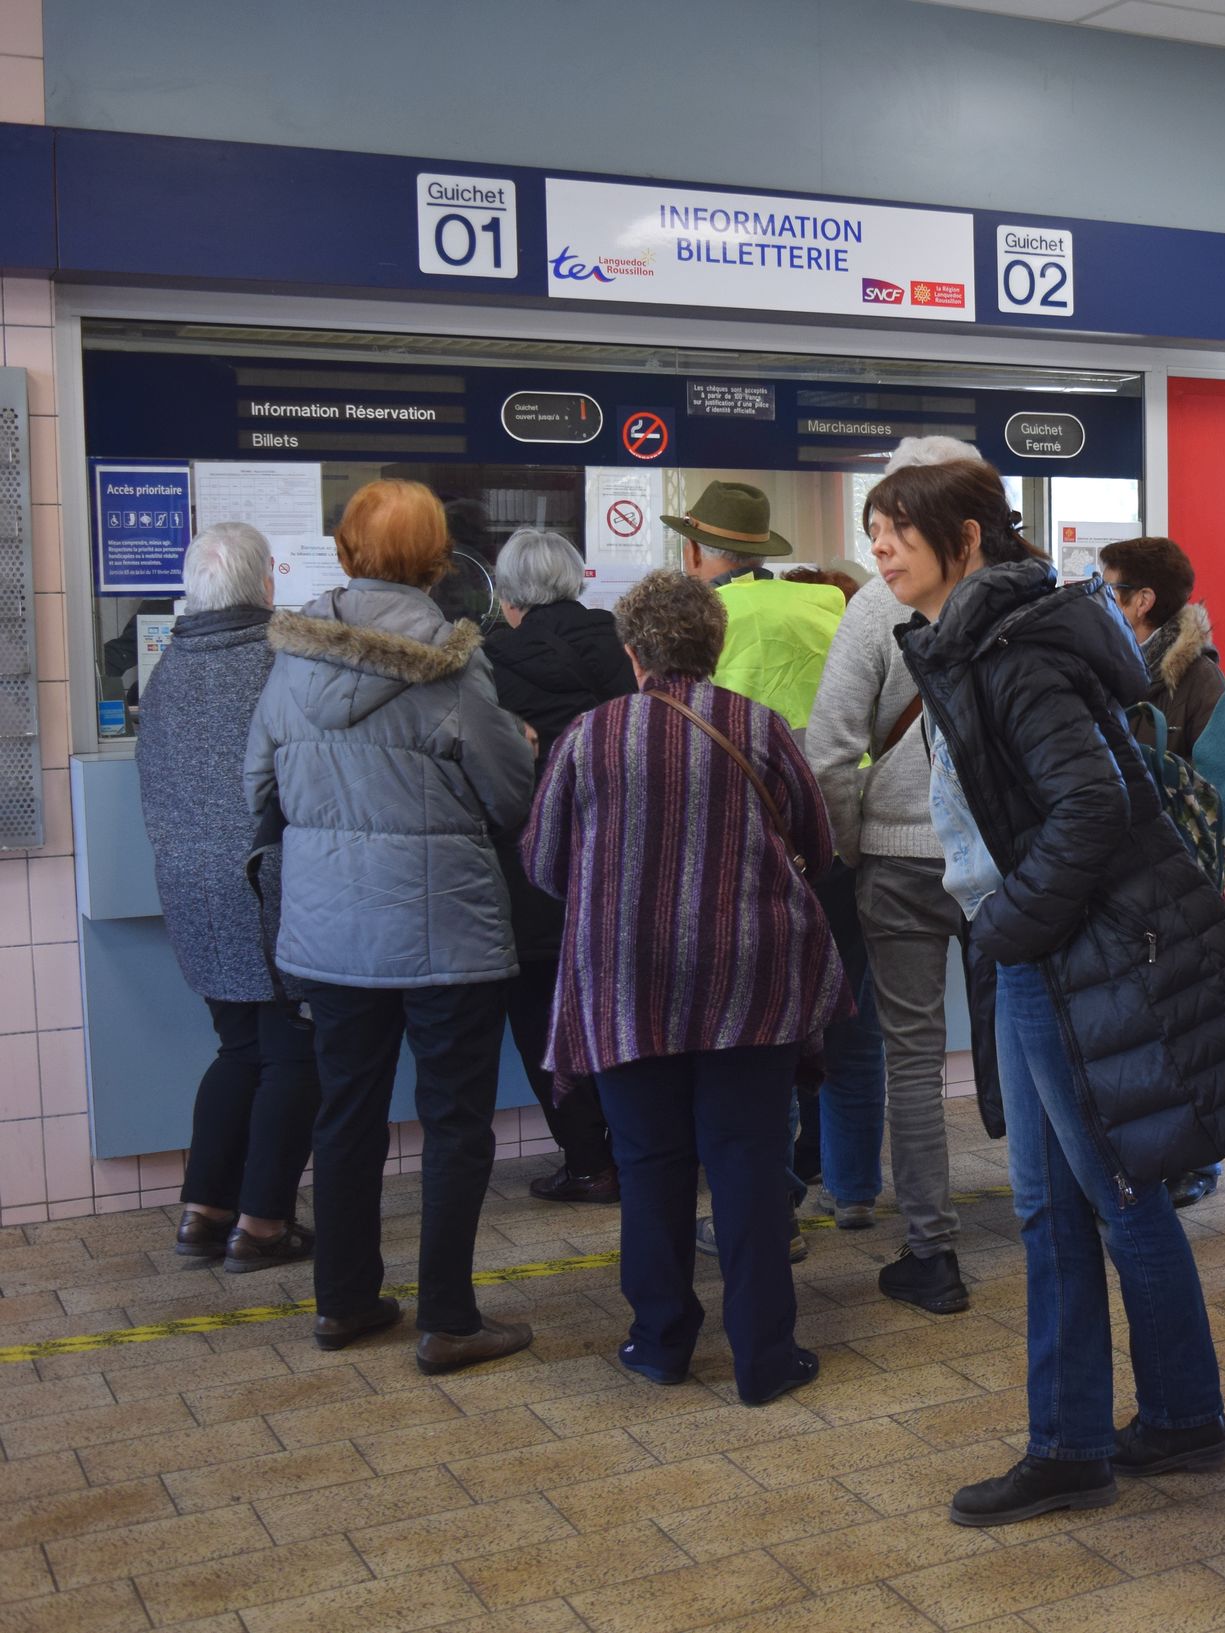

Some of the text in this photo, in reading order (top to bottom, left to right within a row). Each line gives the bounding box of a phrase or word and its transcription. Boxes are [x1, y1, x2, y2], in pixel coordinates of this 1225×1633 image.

[428, 182, 505, 205] Guichet
[660, 204, 862, 243] INFORMATION
[434, 213, 502, 269] 01
[1005, 232, 1064, 252] Guichet
[598, 256, 647, 267] Languedoc
[677, 237, 849, 272] BILLETTERIE
[549, 246, 616, 283] ter
[607, 265, 654, 276] Roussillon
[1003, 259, 1068, 309] 02
[864, 287, 903, 302] SNCF
[251, 402, 436, 420] Information Réservation
[514, 404, 539, 412] Guichet
[538, 413, 560, 422] jusqu'à
[808, 420, 892, 435] Marchandises
[1021, 423, 1063, 436] Guichet
[252, 433, 299, 448] Billets
[1025, 440, 1061, 452] Fermé
[106, 483, 182, 497] Accès prioritaire
